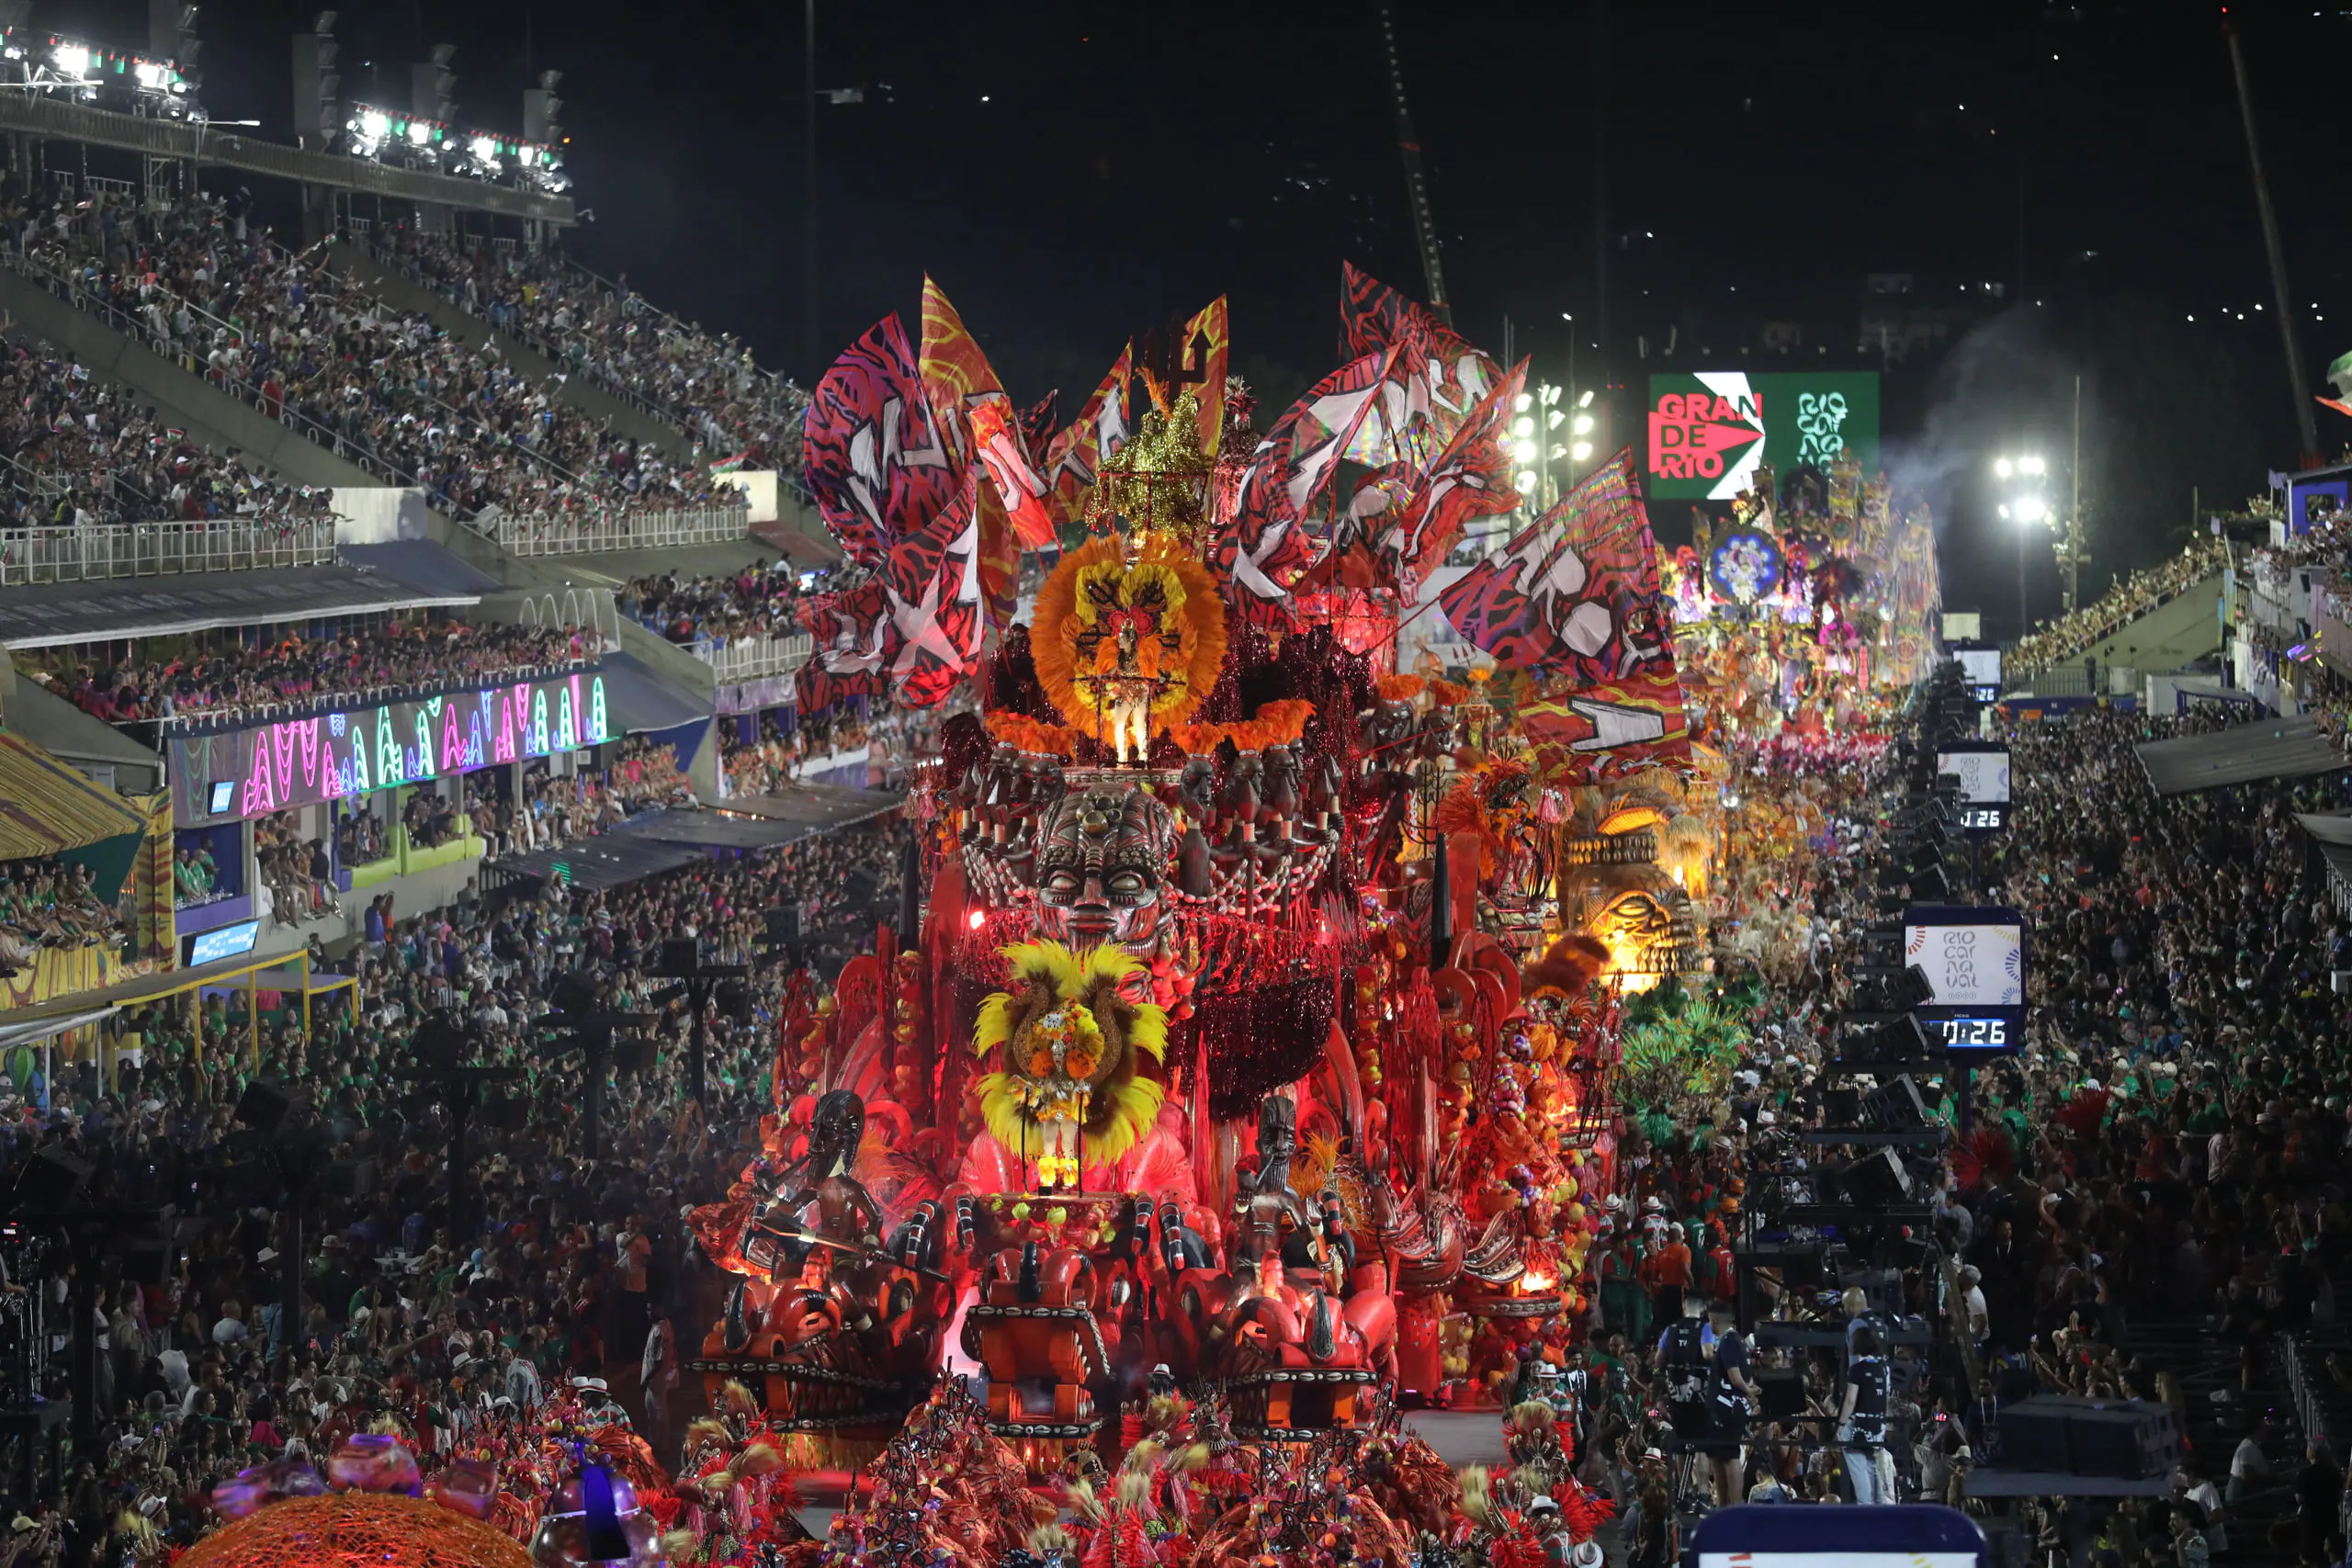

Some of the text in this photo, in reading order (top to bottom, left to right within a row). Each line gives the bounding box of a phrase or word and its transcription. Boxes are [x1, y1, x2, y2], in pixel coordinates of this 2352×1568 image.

[1657, 392, 1763, 422] GRAN
[1661, 425, 1706, 448] DE
[1679, 1339, 1688, 1348] TV
